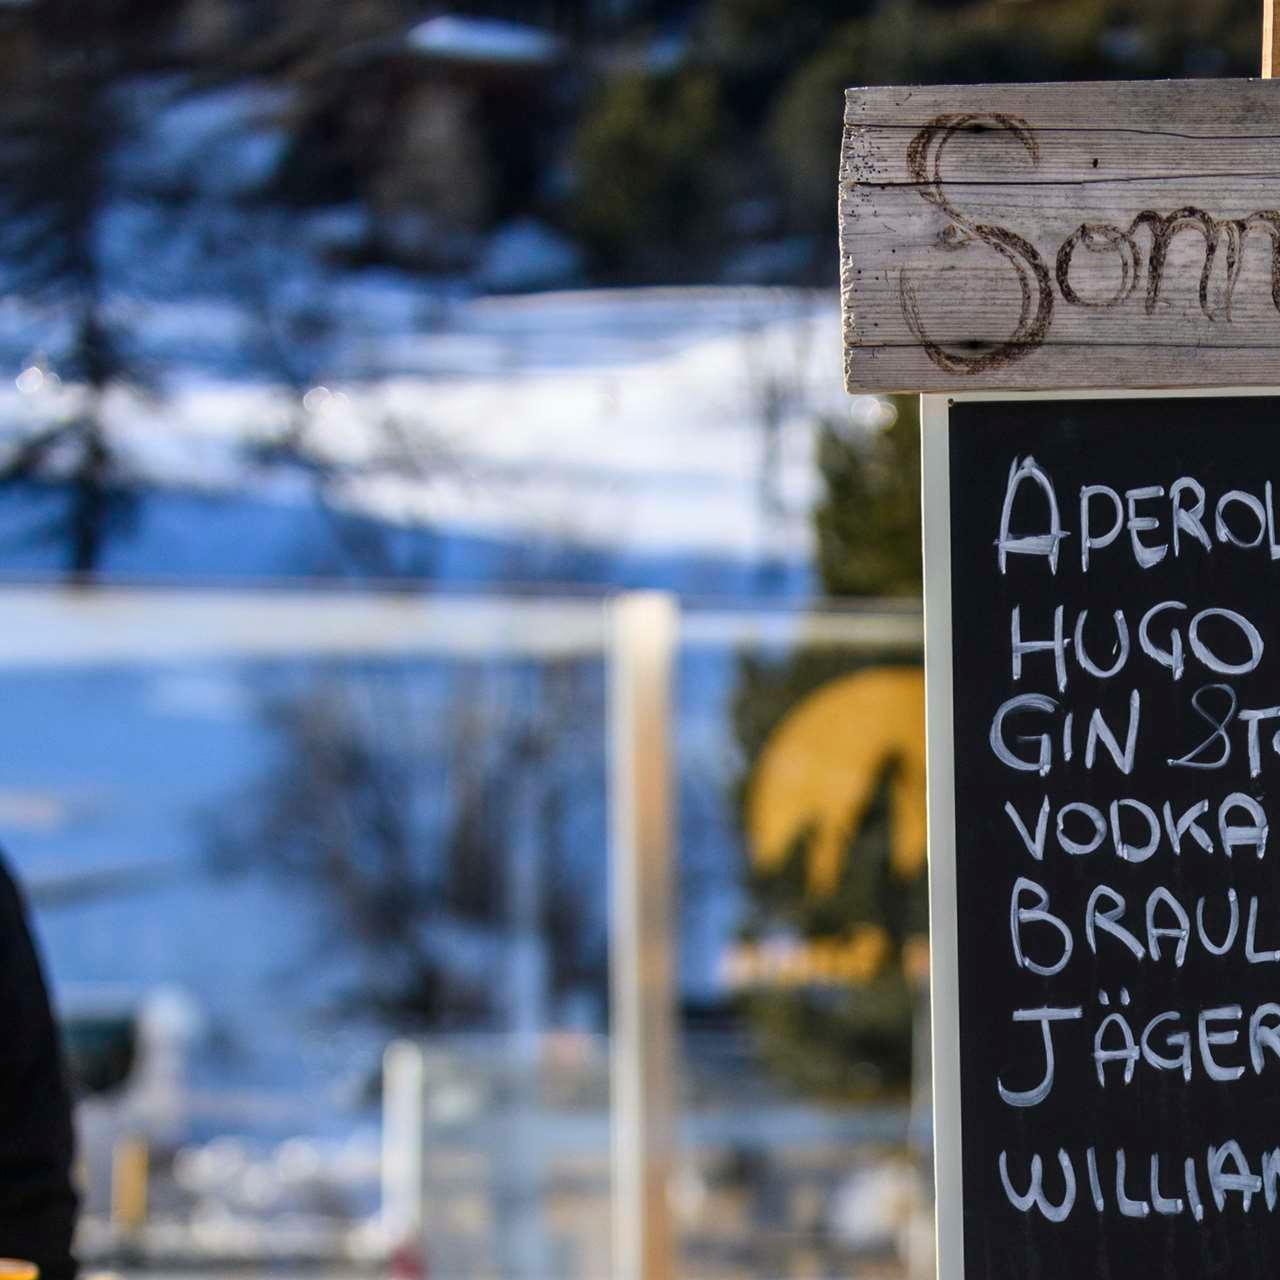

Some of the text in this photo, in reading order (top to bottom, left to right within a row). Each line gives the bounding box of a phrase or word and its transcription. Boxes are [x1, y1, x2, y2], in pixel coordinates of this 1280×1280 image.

[1011, 601, 1265, 693] HUGO
[989, 689, 1141, 777] GIN
[1005, 793, 1270, 864] VODKA
